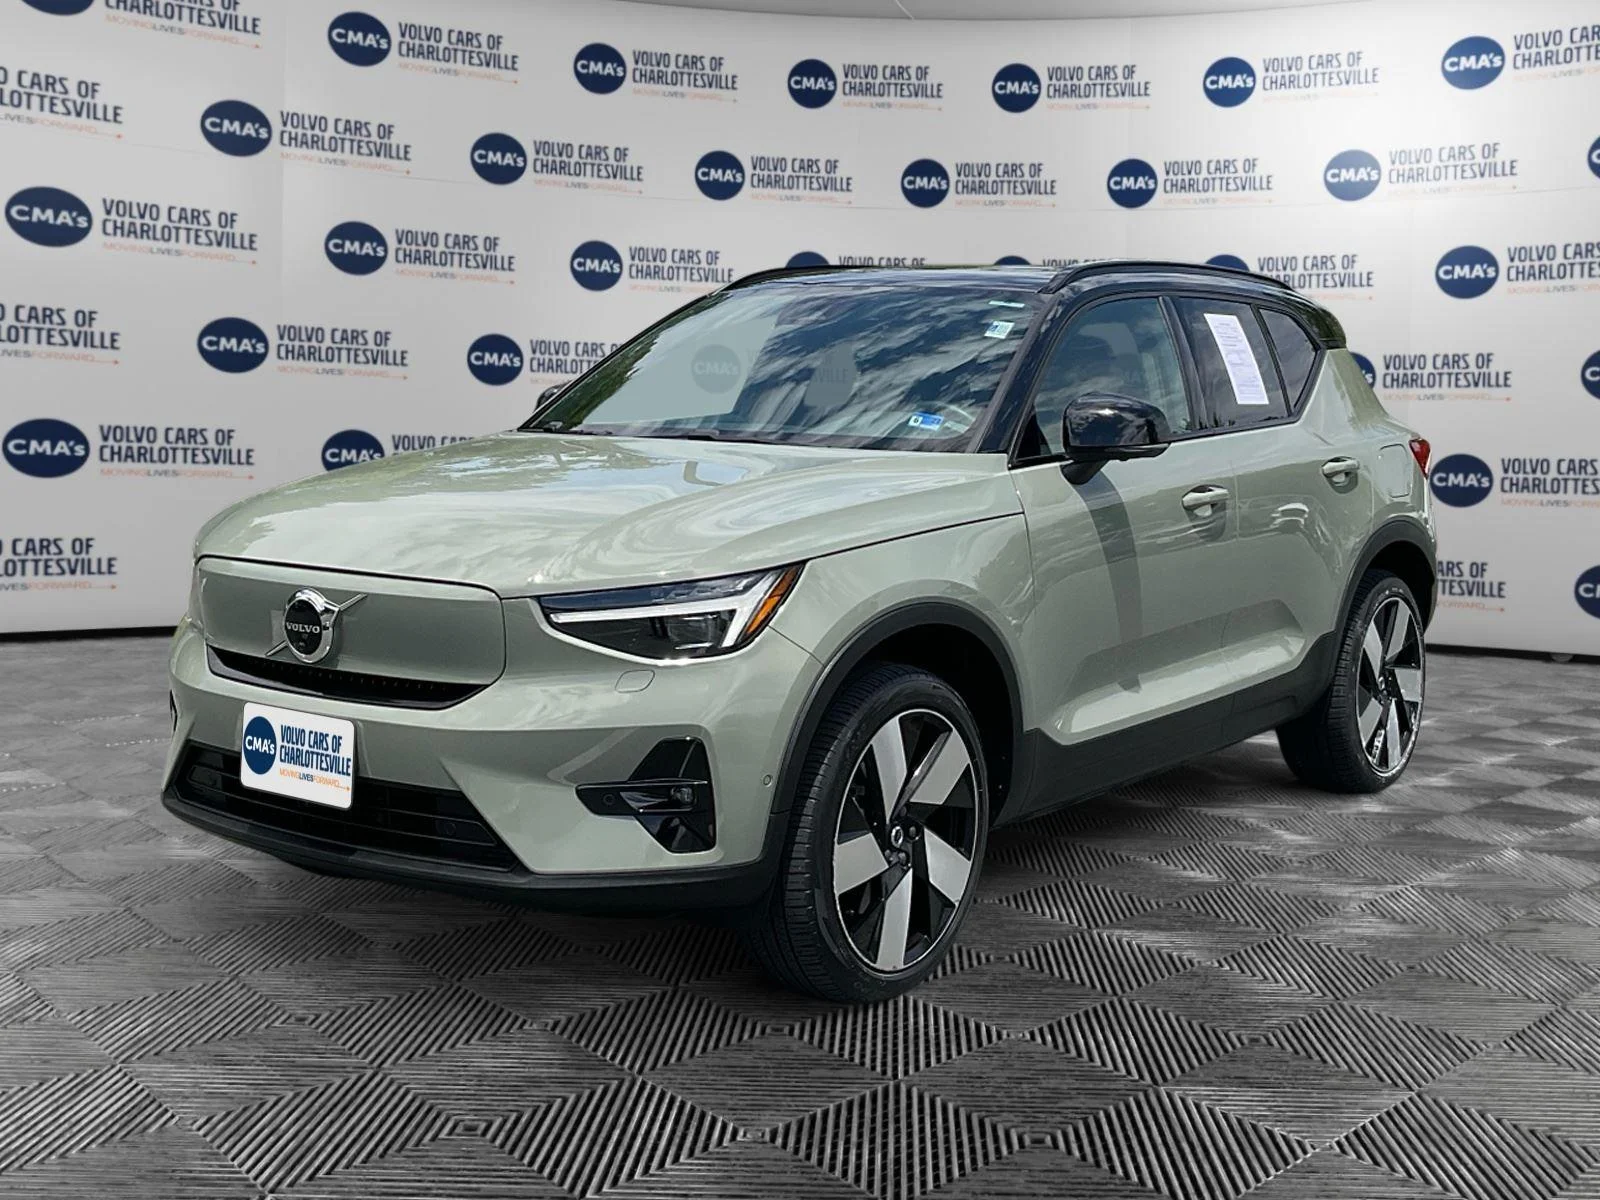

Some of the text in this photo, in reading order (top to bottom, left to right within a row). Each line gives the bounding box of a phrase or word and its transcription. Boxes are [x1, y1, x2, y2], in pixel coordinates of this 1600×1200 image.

[331, 28, 389, 50] CMA's
[398, 22, 503, 52] VOLVO CARS OF
[1514, 24, 1600, 52] VOLVO CAR
[398, 40, 519, 72] CHARLOTTESVILLE
[632, 50, 724, 73] VOLVO CARS OF
[1262, 51, 1363, 74] VOLVO CARS OF
[1443, 53, 1503, 72] CMA's
[1513, 43, 1600, 71] CHARLOTTE
[576, 59, 625, 77] CMA's
[842, 63, 930, 82] VOLVO CARS OF
[1047, 64, 1136, 82] VOLVO CARS OF
[17, 69, 69, 96] CARS
[77, 79, 100, 101] OF
[632, 67, 738, 91] CHARLOTTESVILLE
[790, 76, 835, 91] CMA's
[994, 81, 1039, 95] CMA's
[1205, 73, 1255, 90] CMA's
[1262, 67, 1379, 92] CHARLOTTESVILLE
[842, 80, 943, 99] CHARLOTTESVILLE
[1046, 81, 1150, 99] CHARLOTTESVILLE
[0, 87, 123, 125] LOTTESVILLE
[204, 117, 269, 139] CMA's
[280, 111, 395, 141] VOLVO CARS OF
[279, 129, 412, 162] CHARLOTTESVILLE
[533, 140, 629, 164] VOLVO CARS OF
[1390, 142, 1500, 167] VOLVO CARS OF
[473, 149, 525, 168] CMA's
[750, 156, 839, 175] VOLVO CARS OF
[1163, 158, 1257, 177] VOLVO CARS OF
[532, 157, 643, 182] CHARLOTTESVILLE
[697, 167, 743, 183] CMA's
[955, 163, 1043, 178] VOLVO CARS OF
[1326, 166, 1380, 183] CMA's
[1388, 159, 1519, 186] CHARLOTTESVILLE
[750, 173, 852, 193] CHARLOTTESVILLE
[903, 175, 948, 190] CMA's
[954, 179, 1056, 195] CHARLOTTESVILLE
[1109, 175, 1156, 190] CMA's
[1163, 175, 1272, 194] CHARLOTTESVILLE
[10, 204, 89, 228] CMA's
[102, 198, 238, 230] VOLVO CARS OF
[102, 218, 258, 252] CHARLOTTESVILLE
[395, 229, 500, 253] VOLVO CARS OF
[328, 238, 385, 257] CMA's
[629, 246, 720, 266] VOLVO CARS OF
[1507, 244, 1556, 264] VOLVO
[395, 247, 515, 272] CHARLOTTESVILLE
[572, 257, 621, 274] CMA's
[1258, 254, 1358, 272] VOLVO CARS OF
[628, 263, 734, 284] CHARLOTTESVILLE
[1271, 271, 1374, 289] ARLOTTESVILLE
[1438, 263, 1496, 280] CMA's
[1507, 260, 1600, 283] CHARLOTTE
[14, 304, 66, 327] CARS
[74, 309, 98, 329] OF
[0, 324, 120, 351] OTTESVILLE
[201, 335, 266, 354] CMA's
[277, 325, 391, 348] VOLVO CARS OF
[276, 343, 408, 367] CHARLOTTESVILLE
[530, 339, 570, 356] VOLVO
[575, 341, 606, 357] CARS
[470, 351, 521, 367] CMA's
[530, 357, 597, 374] CHARLOTT
[1383, 353, 1494, 371] VOLVO CARS OF
[1382, 371, 1512, 389] CHARLOTTESVILLE
[99, 425, 235, 446] VOLVO CARS OF
[392, 434, 436, 451] VOLVO
[7, 439, 86, 457] CMA's
[99, 445, 254, 466] CHARLOTTESVILLE
[1501, 457, 1598, 476] VOLVO CARS
[1432, 472, 1490, 488] CMA's
[1500, 476, 1600, 495] CHARLOTTES
[11, 537, 64, 556] CARS
[71, 537, 95, 556] OF
[0, 557, 117, 577] OTTESVILLE
[1438, 560, 1488, 579] ARS OF
[1438, 578, 1506, 599] TESVILLE
[286, 621, 320, 634] VOLVO
[245, 735, 275, 755] CMA's
[280, 724, 342, 755] VOLVO CARS OF
[279, 744, 352, 777] CHARLOTTESVILLE
